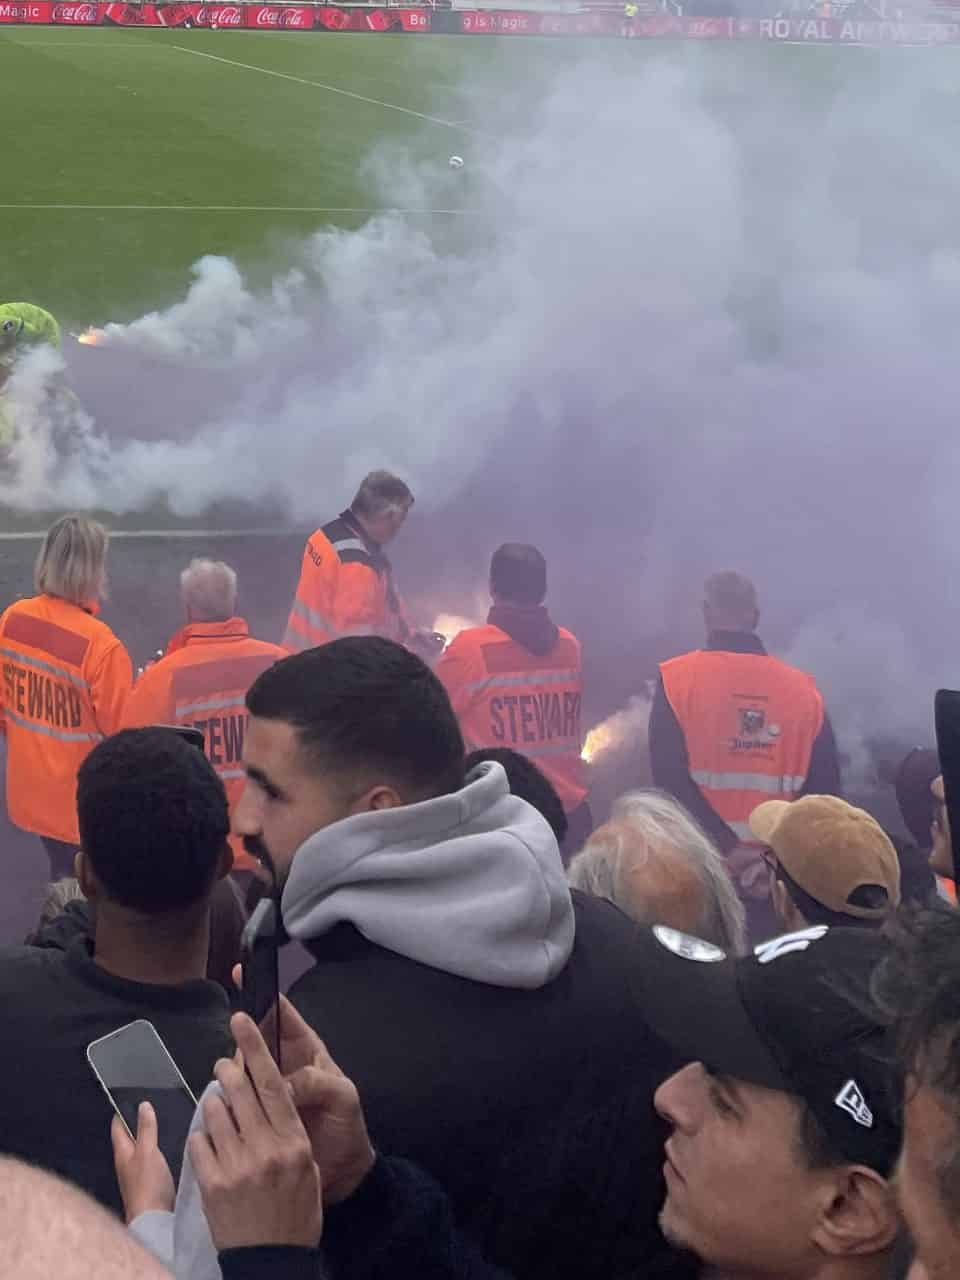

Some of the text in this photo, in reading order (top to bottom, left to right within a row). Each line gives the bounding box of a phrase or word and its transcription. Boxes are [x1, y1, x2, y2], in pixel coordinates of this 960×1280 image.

[0, 4, 40, 18] Magic
[2, 664, 82, 727] STEWARD
[489, 691, 582, 743] STEWAR
